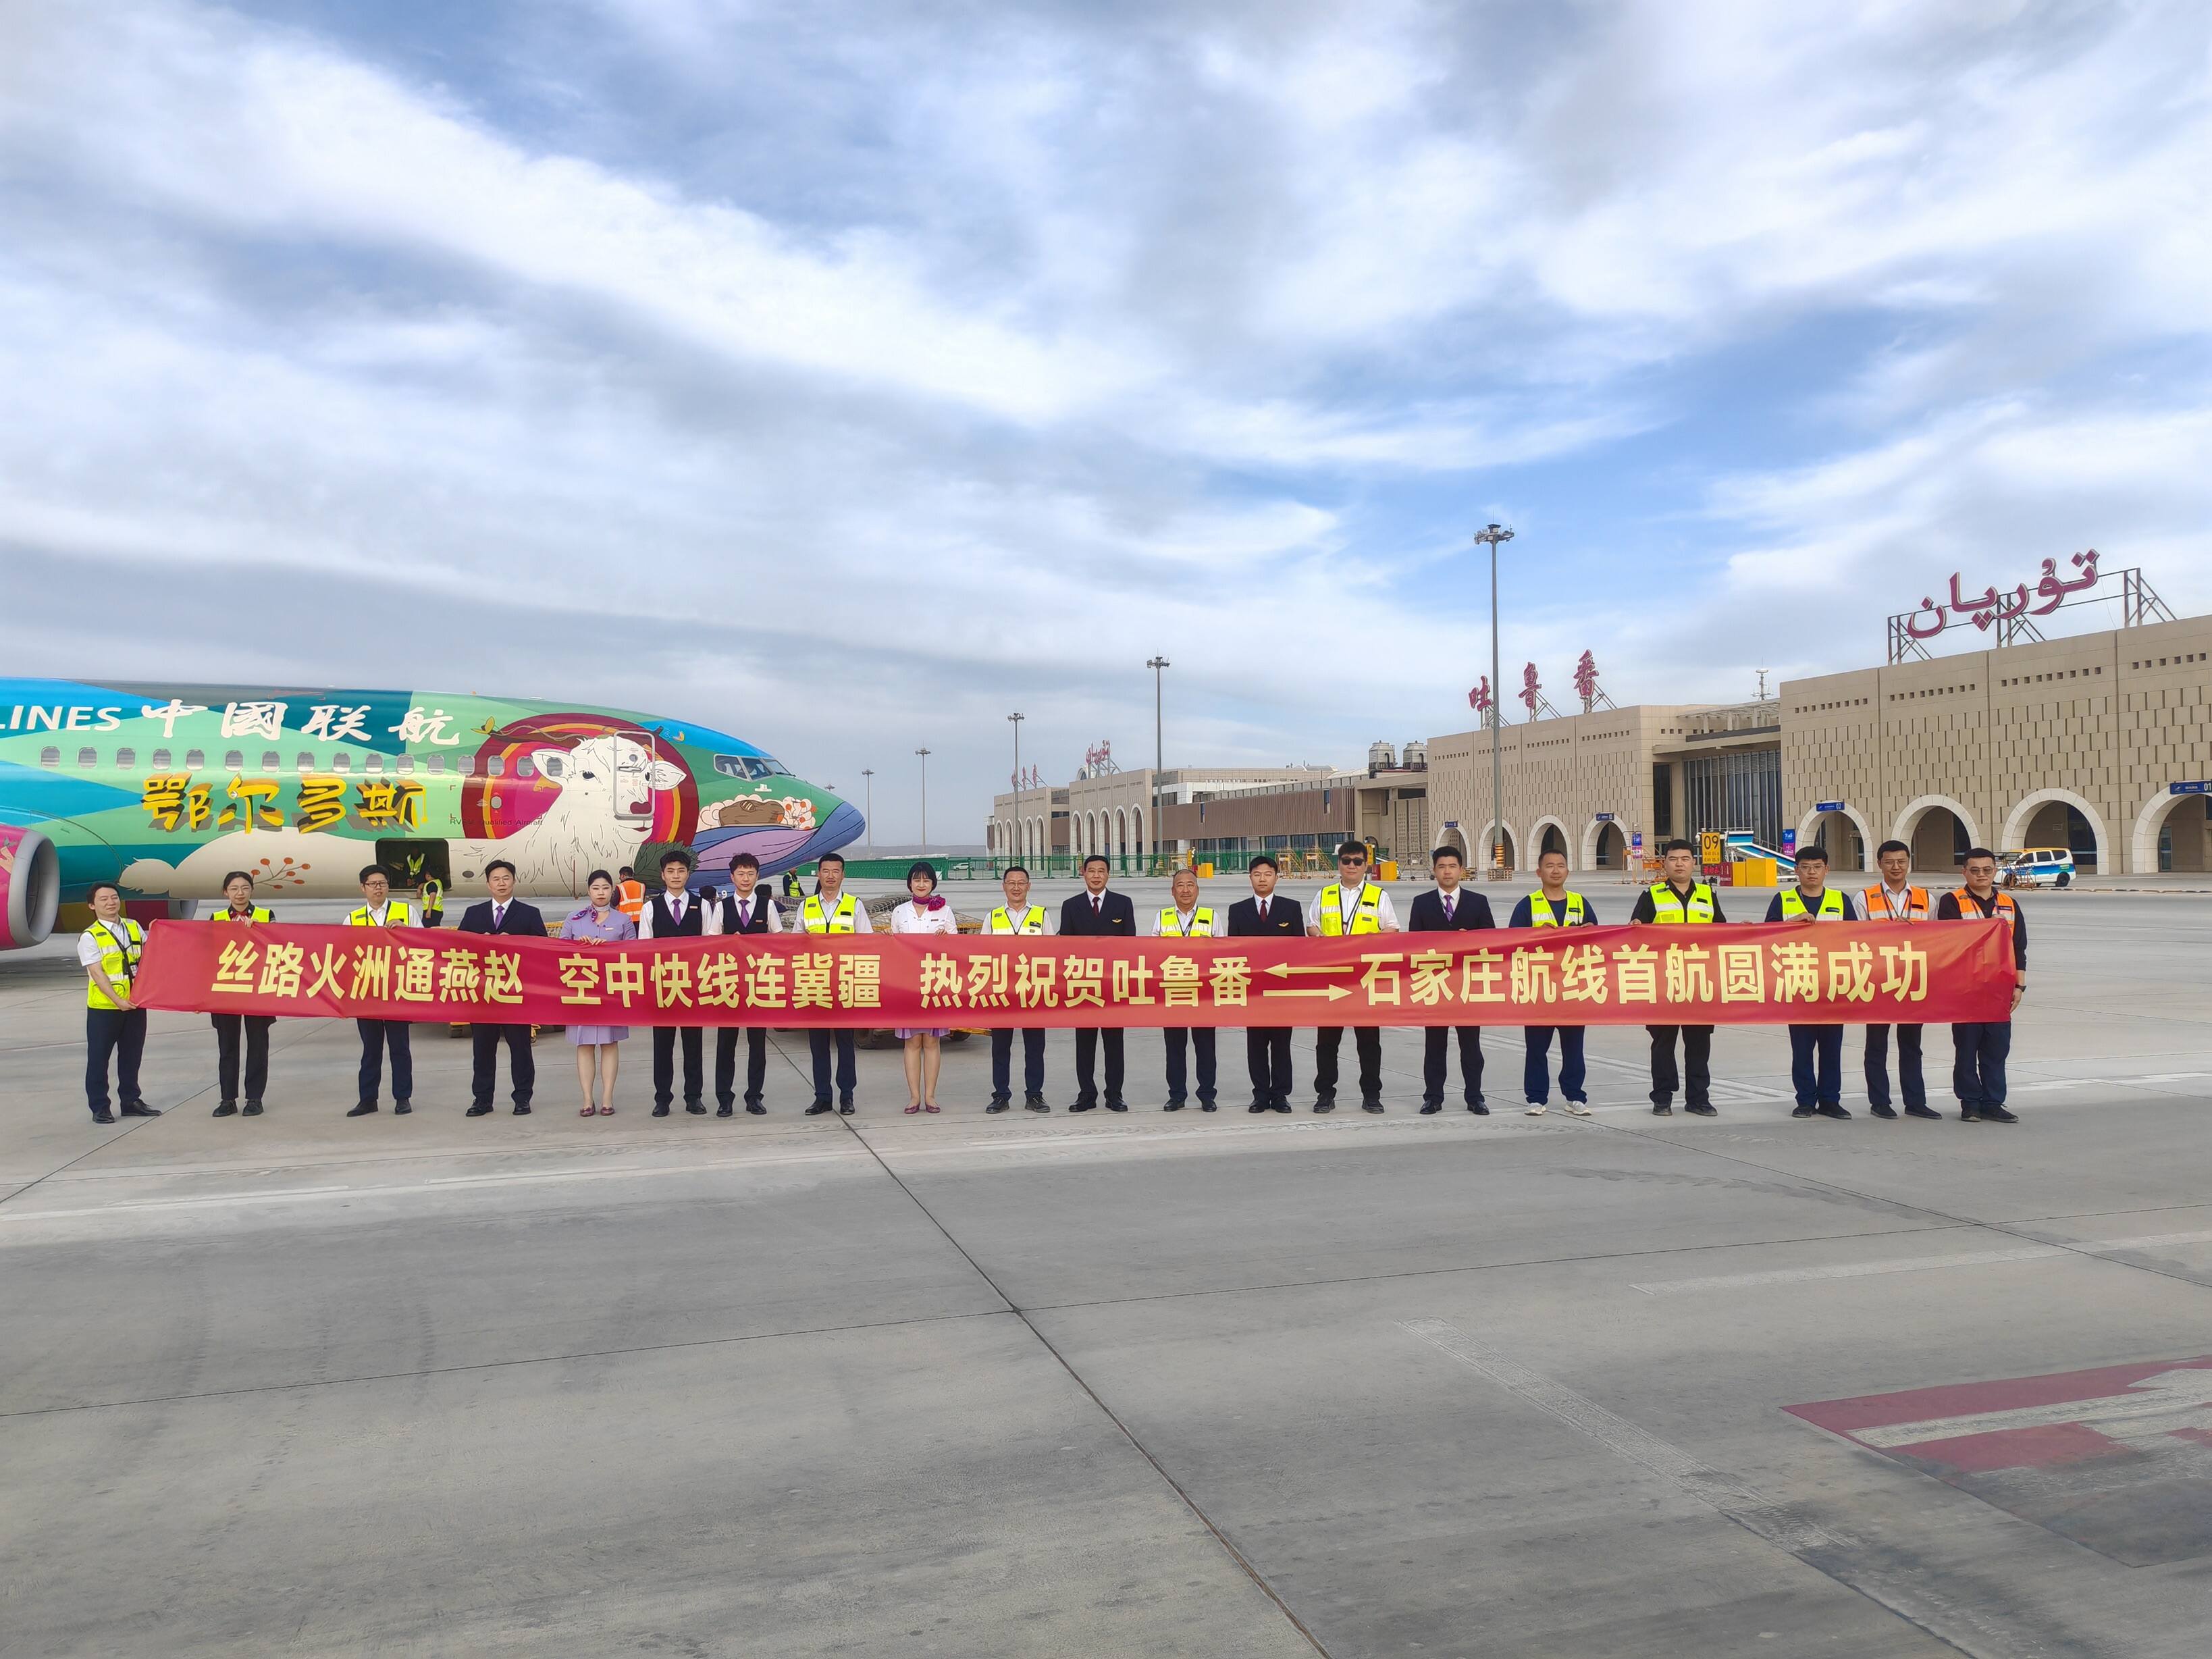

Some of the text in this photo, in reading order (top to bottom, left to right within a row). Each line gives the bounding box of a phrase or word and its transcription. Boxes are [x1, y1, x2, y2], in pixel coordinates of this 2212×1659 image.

[1907, 548, 2101, 639] تۇرپان
[1469, 649, 1599, 712] 吐鲁番
[141, 772, 428, 835] 鄂尔多斯
[1704, 835, 1719, 850] 09
[211, 939, 1929, 1009] 丝路火洲通燕赵 空中快线连冀疆 热烈祝贺吐鲁番 石家庄航线首航圆满成功
